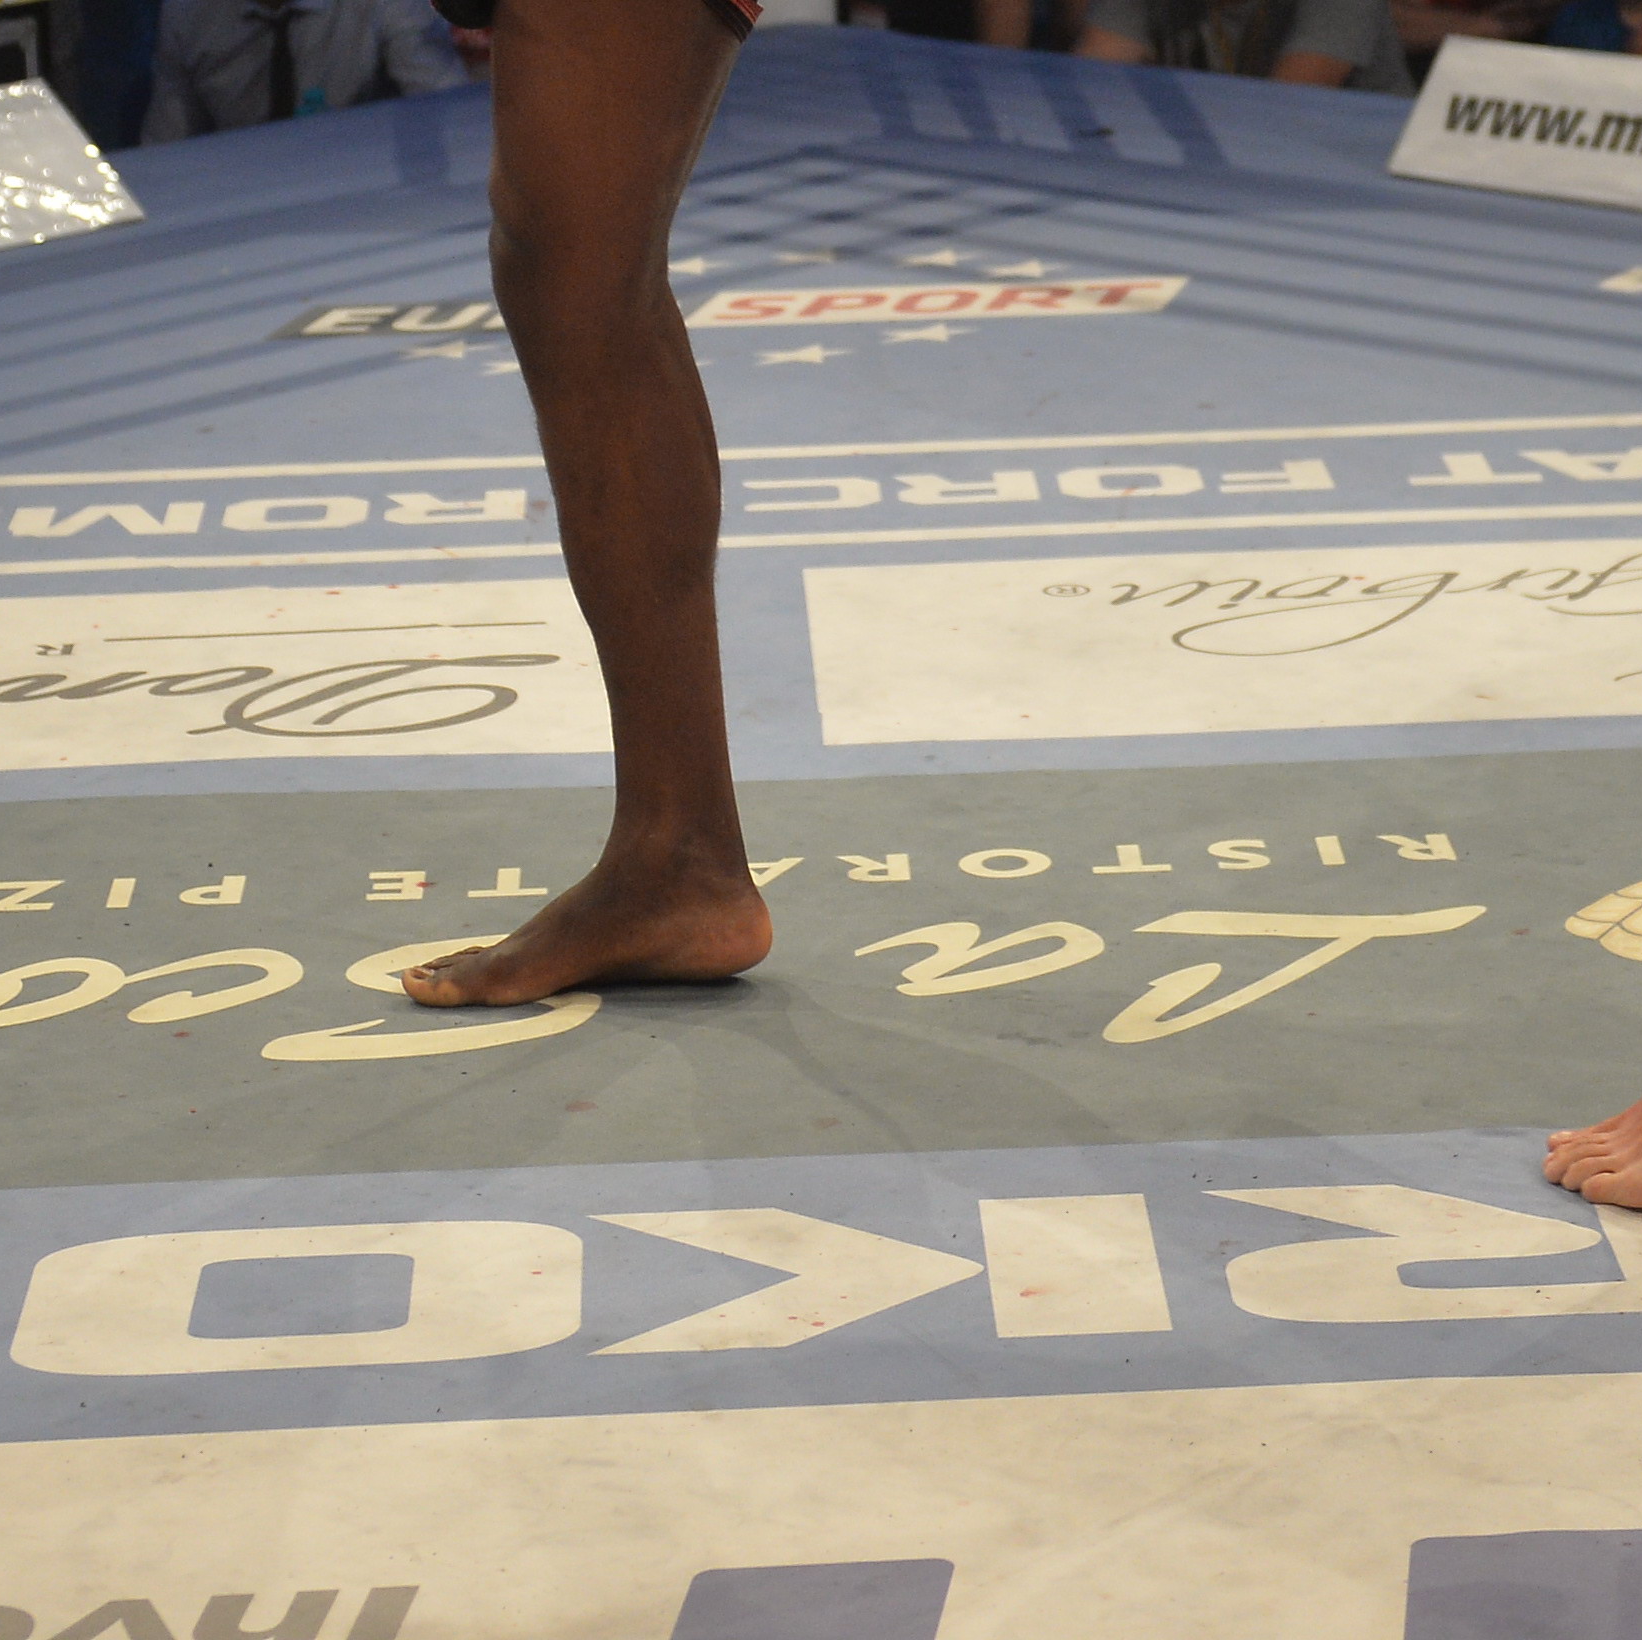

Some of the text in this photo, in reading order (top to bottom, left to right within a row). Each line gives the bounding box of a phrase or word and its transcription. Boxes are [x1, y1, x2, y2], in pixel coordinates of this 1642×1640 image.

[743, 458, 1336, 513] FORC
[367, 832, 1461, 902] RISTORATE
[855, 905, 1487, 1044] La
